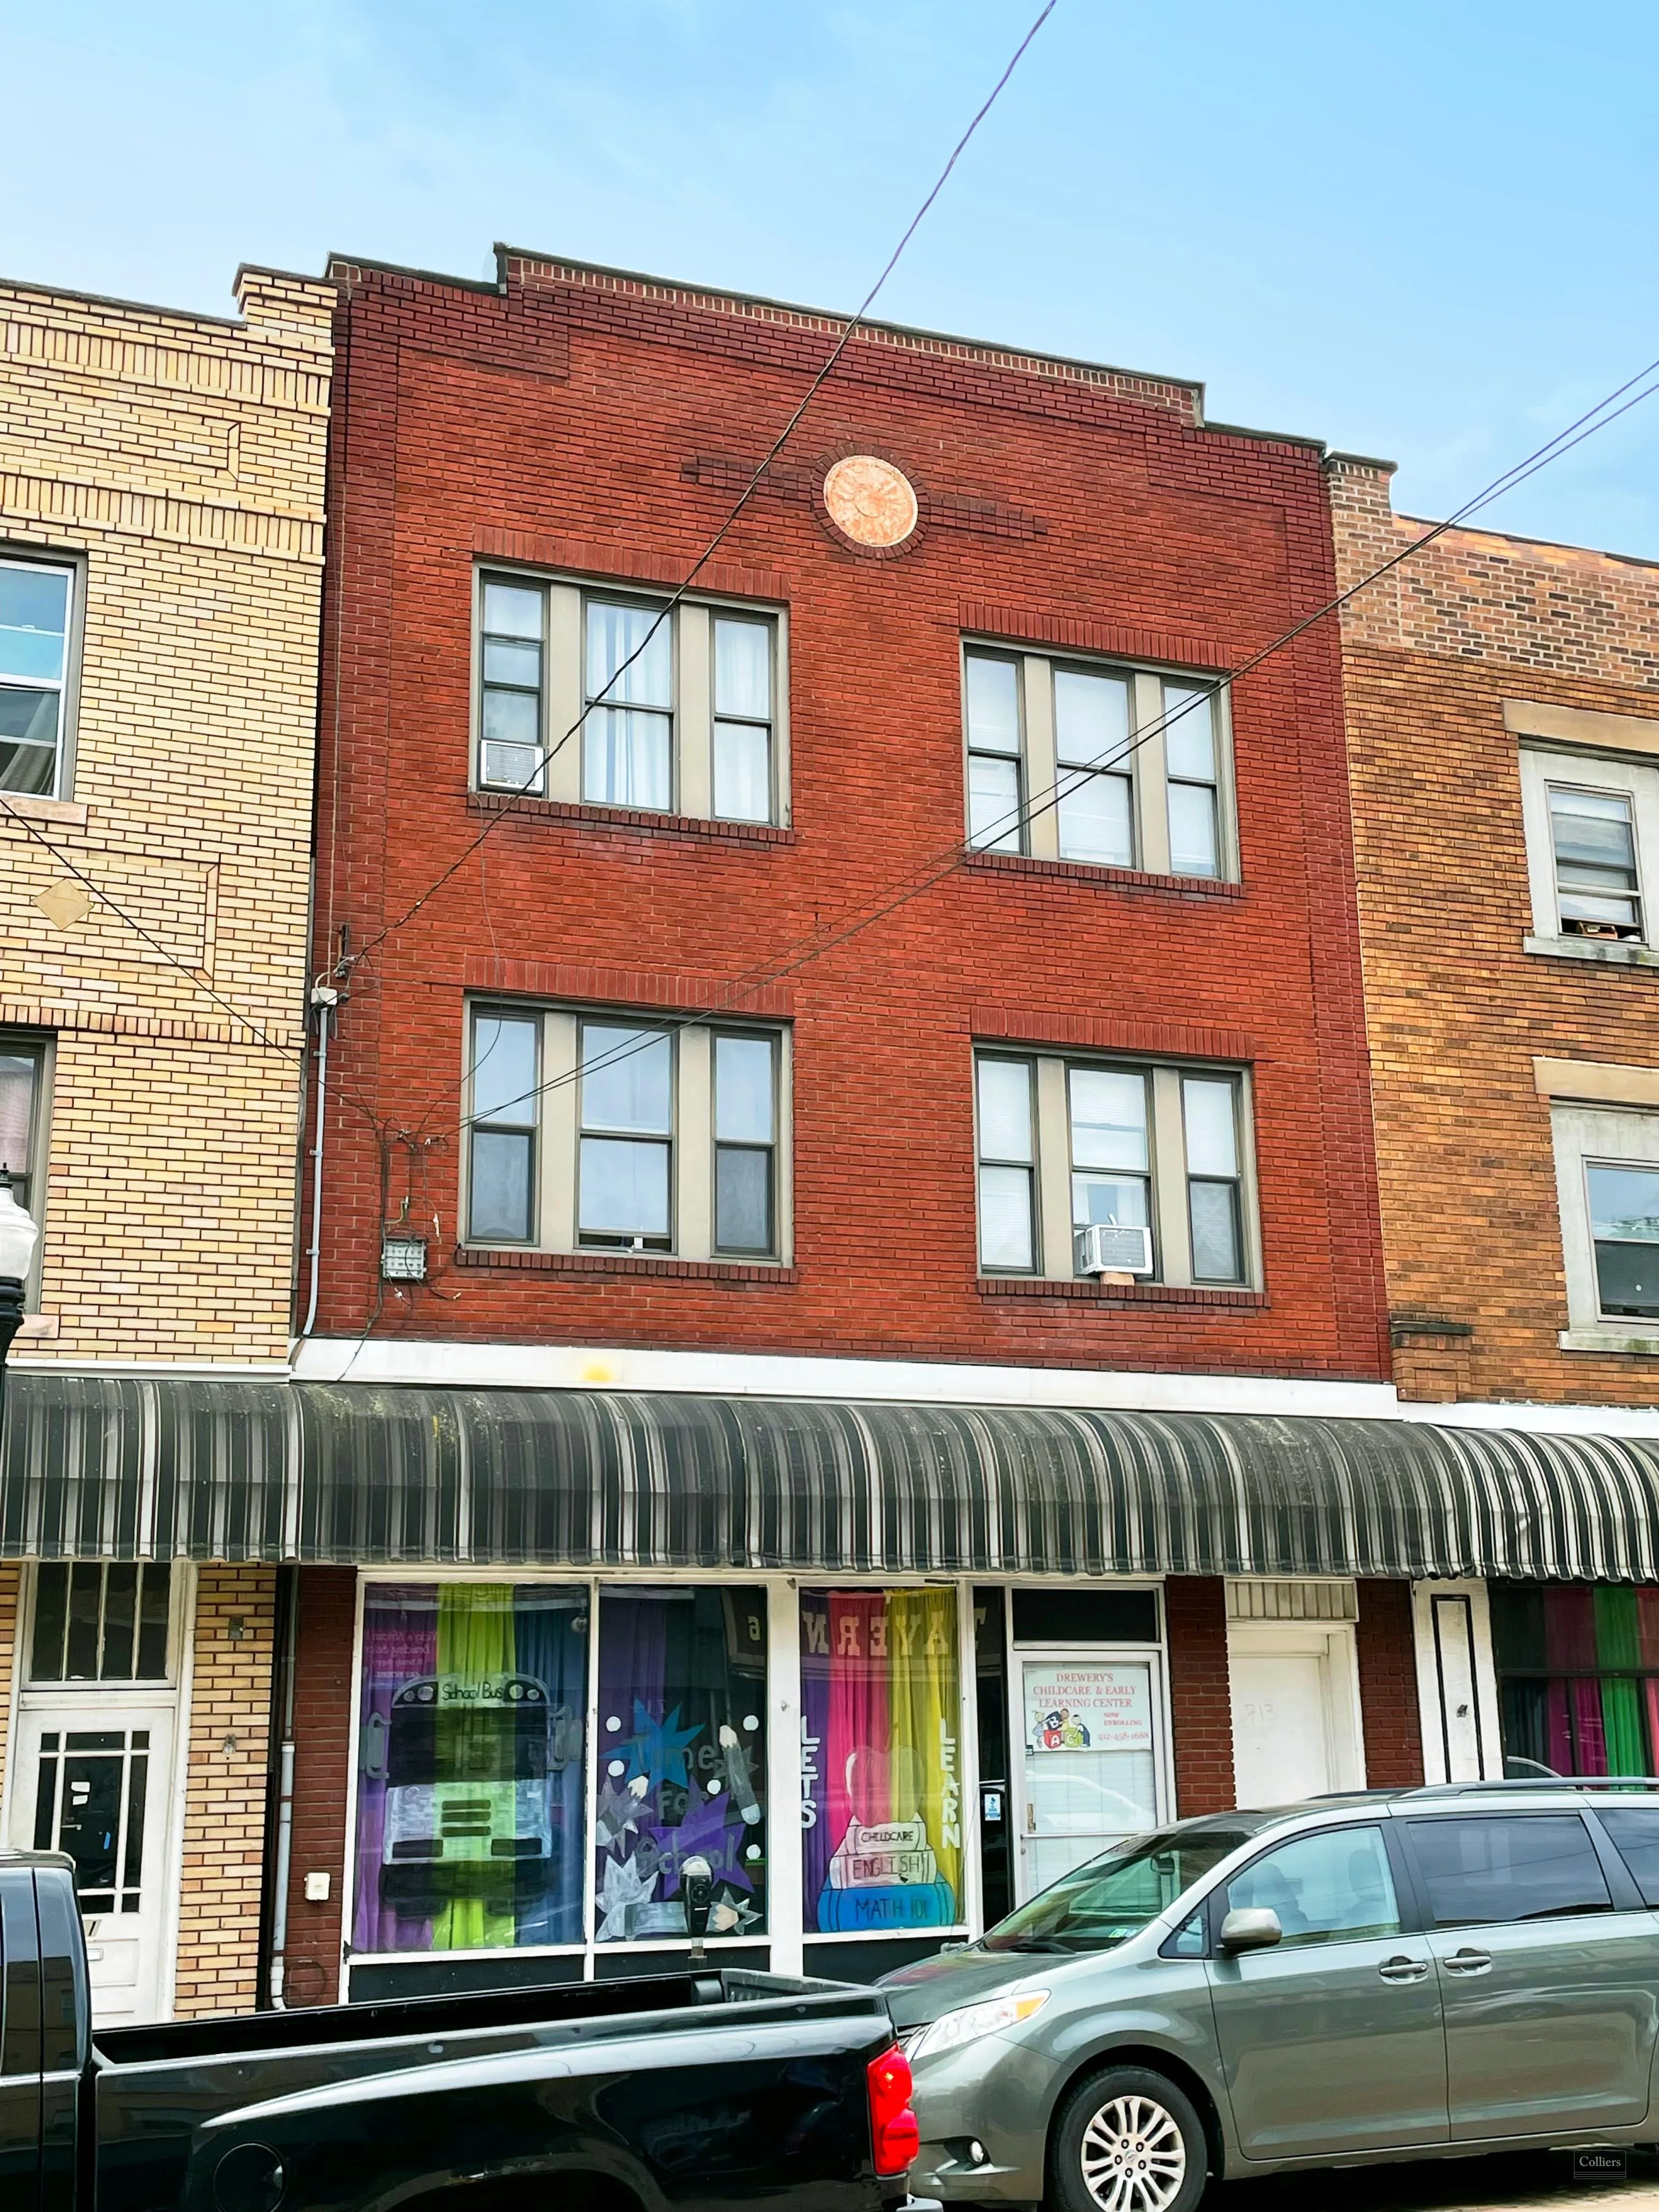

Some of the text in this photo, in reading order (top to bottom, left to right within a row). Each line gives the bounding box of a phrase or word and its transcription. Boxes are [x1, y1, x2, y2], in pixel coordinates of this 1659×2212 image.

[1056, 1673, 1113, 1682] DREWERY'S
[442, 1681, 503, 1700] School Bus
[1033, 1686, 1136, 1695] CHILDCARE & EARLY
[1039, 1699, 1132, 1708] LEARNING CENTER
[939, 1717, 960, 1849] LEARN
[861, 1831, 914, 1842] CHILDCARE
[635, 1830, 735, 1879] Schol
[853, 1855, 919, 1879] ENGLISH
[855, 1898, 904, 1921] MATH
